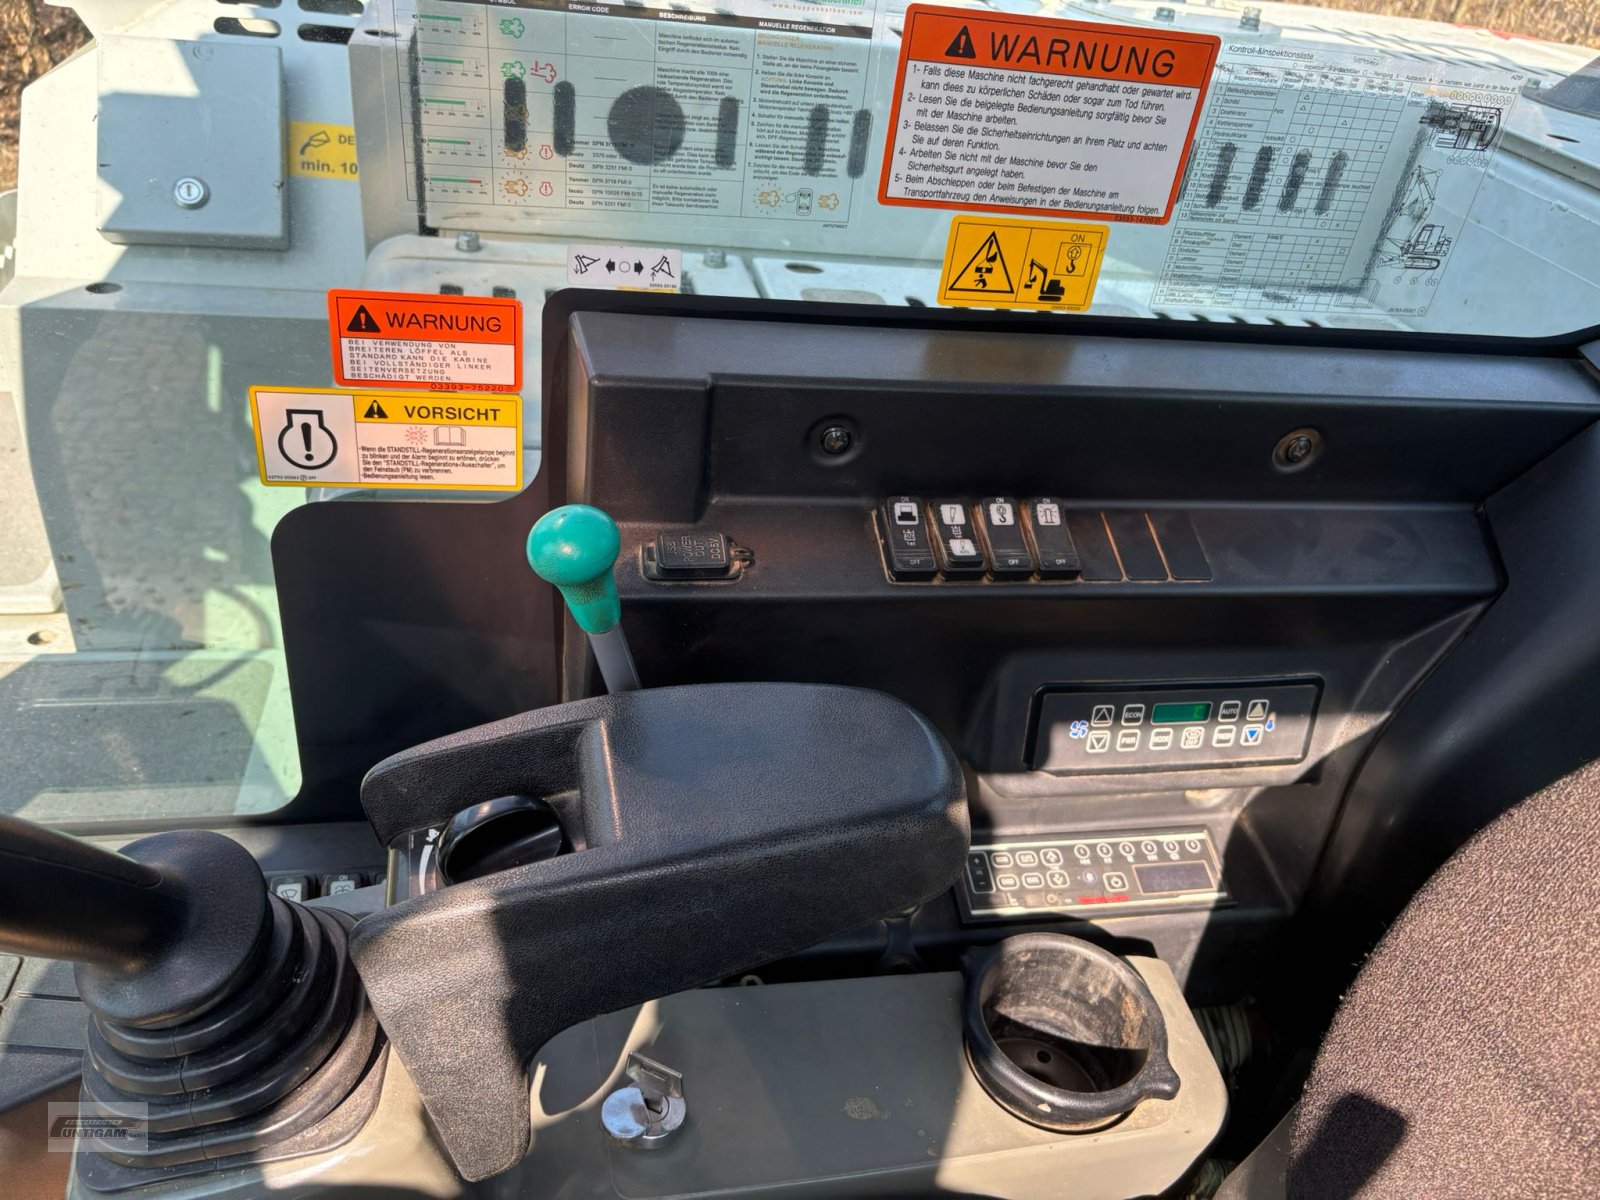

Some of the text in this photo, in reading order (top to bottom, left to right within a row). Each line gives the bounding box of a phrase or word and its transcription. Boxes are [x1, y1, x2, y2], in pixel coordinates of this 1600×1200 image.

[659, 12, 706, 22] BESCHREIBUNG
[759, 21, 836, 33] MANUELLE REGENERATION
[990, 32, 1175, 77] WARNUNG
[923, 65, 941, 76] Falls
[944, 68, 966, 78] diese
[968, 70, 1005, 82] Maschine
[1007, 74, 1026, 84] nicht
[1029, 76, 1074, 88] fachgerecht
[1076, 81, 1120, 93] gehandhabt
[1122, 85, 1140, 94] oder
[1141, 88, 1174, 98] gewartet
[1176, 90, 1192, 99] wird.
[921, 80, 940, 89] kann
[978, 85, 1026, 97] körperlichen
[1028, 89, 1061, 101] Schäden
[1063, 94, 1082, 103] oder
[1083, 97, 1105, 106] sogar
[1125, 98, 1139, 108] Tod
[1140, 100, 1165, 110] führen.
[916, 108, 1017, 124] mit der Maschine arbeiten.
[919, 94, 942, 104] Lesen
[945, 95, 958, 106] Sie
[960, 97, 972, 107] die
[975, 99, 1015, 112] beigelegte
[1017, 103, 1094, 119] Bedienungsanleitung
[1095, 111, 1130, 123] sorgfältig
[1132, 113, 1153, 123] bevor
[1155, 115, 1167, 125] Sie
[912, 134, 1000, 150] Sie auf deren Funktion.
[914, 121, 949, 132] Belassen
[952, 124, 964, 134] Sie
[966, 126, 979, 135] die
[981, 127, 1071, 143] Sicherheitseinrichtungen
[1085, 136, 1105, 146] Ihrem
[1107, 138, 1125, 148] Platz
[1127, 141, 1142, 149] und
[1143, 142, 1168, 151] achten
[301, 160, 335, 173] min.
[909, 148, 942, 158] Arbeiten
[944, 150, 957, 160] Sie
[959, 152, 978, 162] nicht
[980, 154, 992, 163] mit
[994, 155, 1007, 164] der
[1009, 156, 1044, 167] Maschine
[1046, 160, 1068, 169] bevor
[1069, 161, 1082, 170] Sie
[1084, 163, 1098, 171] den
[907, 161, 1025, 178] Sicherheitsgurt angelegt haben.
[905, 174, 924, 183] Beim
[926, 176, 975, 187] Abschleppen
[978, 180, 995, 189] oder
[997, 181, 1015, 190] beim
[1017, 183, 1056, 194] Befestigen
[1058, 186, 1071, 195] der
[1073, 187, 1106, 198] Maschine
[904, 187, 971, 202] Transportfahrzeug
[988, 194, 1038, 207] Anweisungen
[1049, 199, 1061, 207] der
[1064, 199, 1134, 212] Bedienungsanleitung
[1138, 205, 1159, 214] folgen.
[1071, 234, 1085, 242] ON
[386, 312, 501, 332] WARNUNG
[350, 366, 445, 374] SEITENVERSETZUNG
[404, 406, 500, 421] VORSICHT
